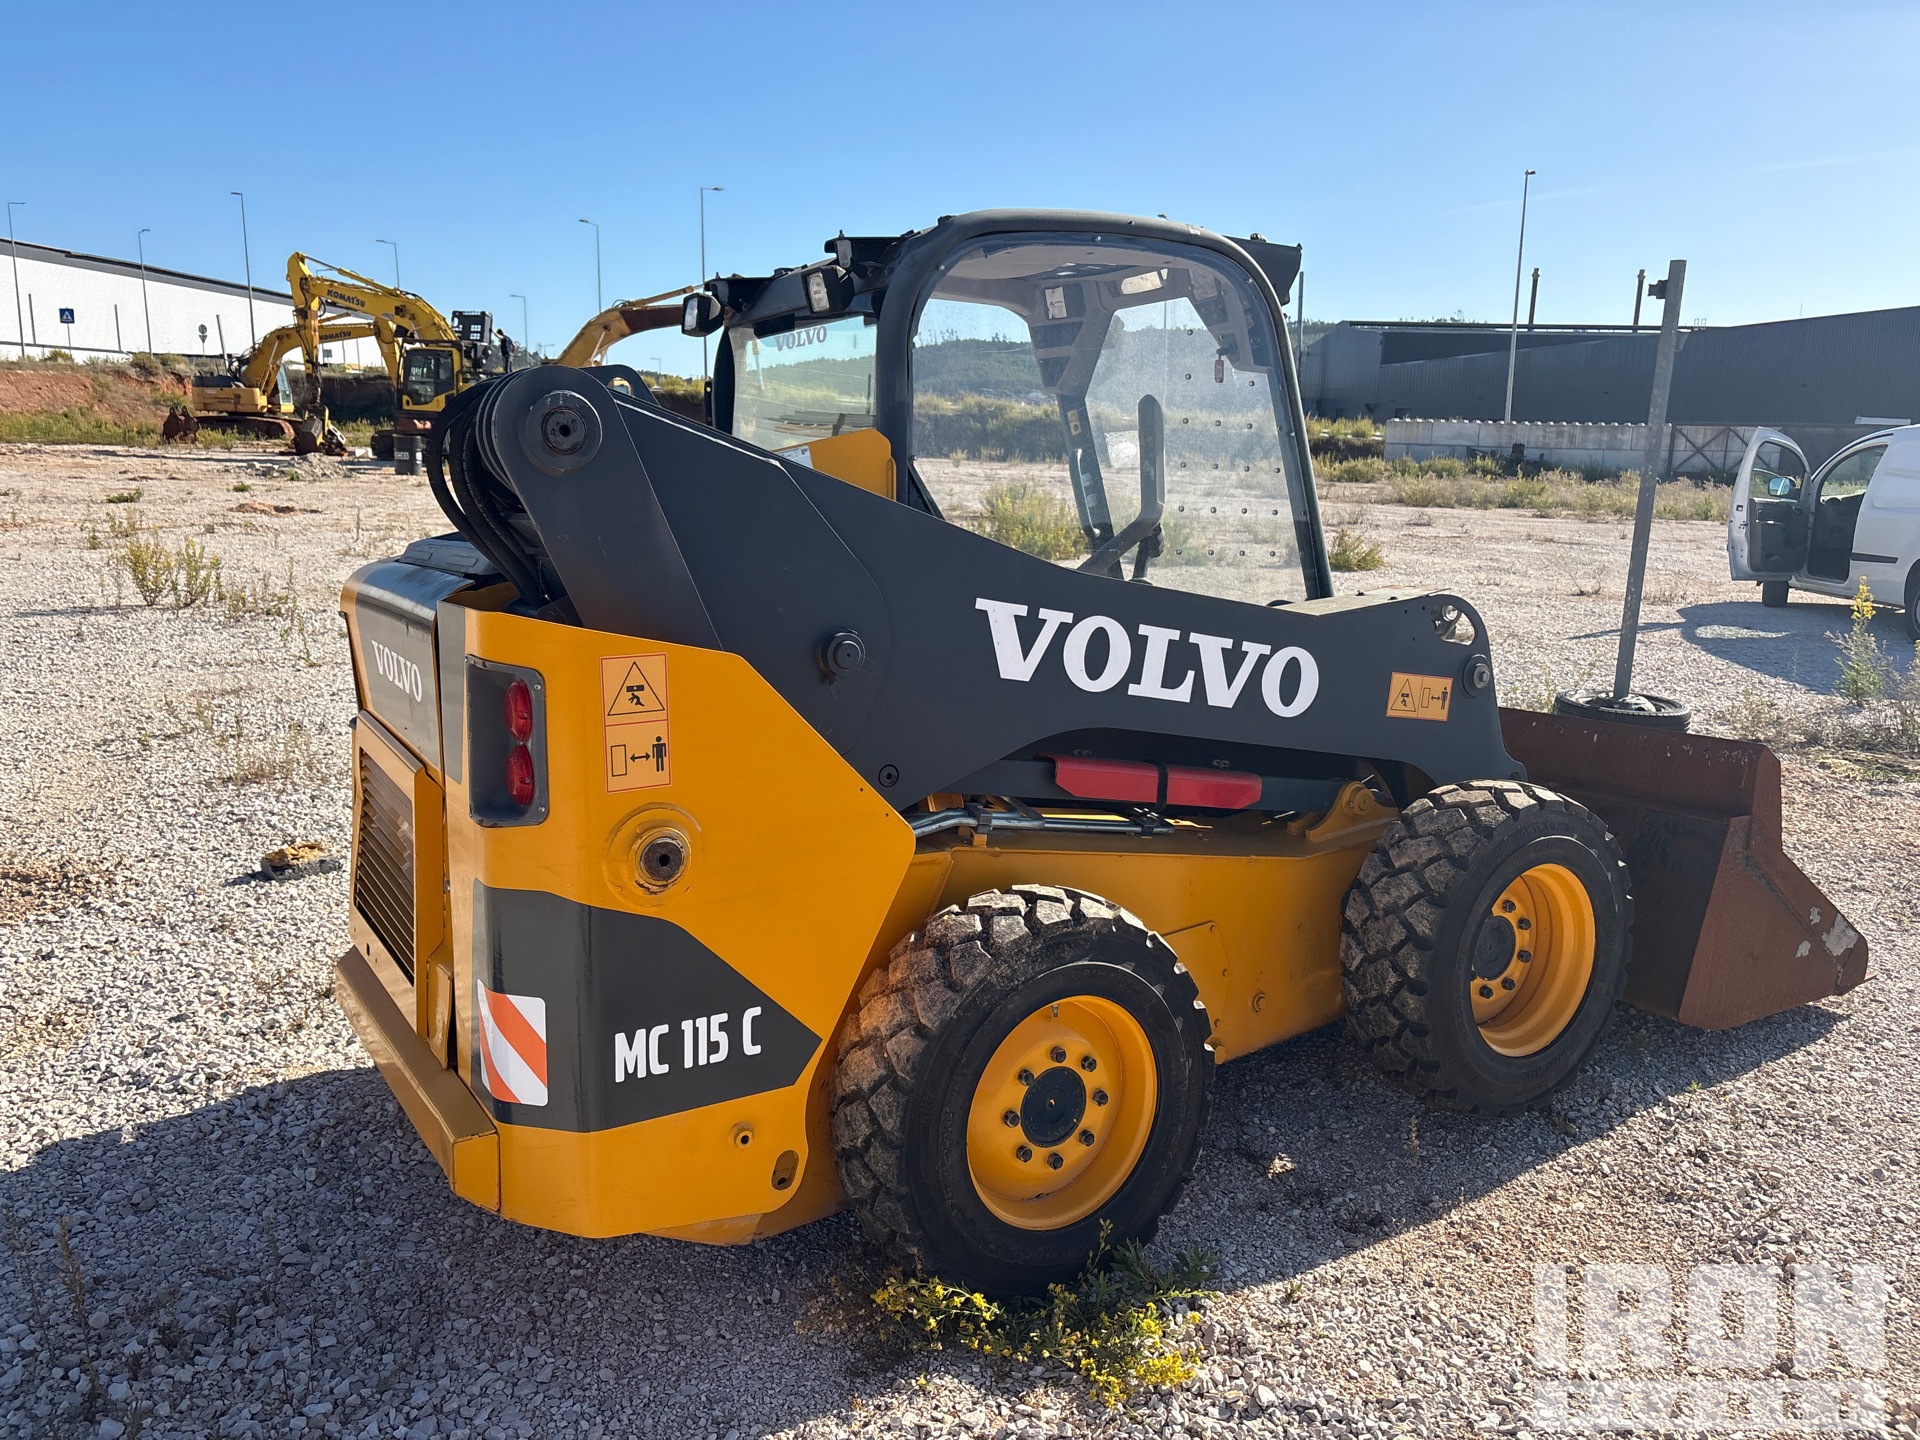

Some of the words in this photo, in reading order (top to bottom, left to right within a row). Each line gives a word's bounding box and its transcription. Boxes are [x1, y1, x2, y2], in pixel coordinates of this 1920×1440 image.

[327, 289, 365, 307] KOMATSU
[319, 331, 351, 340] KOMATSU
[774, 326, 827, 351] VOLVO
[371, 640, 422, 702] VOLVO
[975, 598, 1320, 718] VOLVO
[614, 1023, 670, 1083] MC
[681, 1012, 729, 1069] 115
[743, 1006, 762, 1056] C
